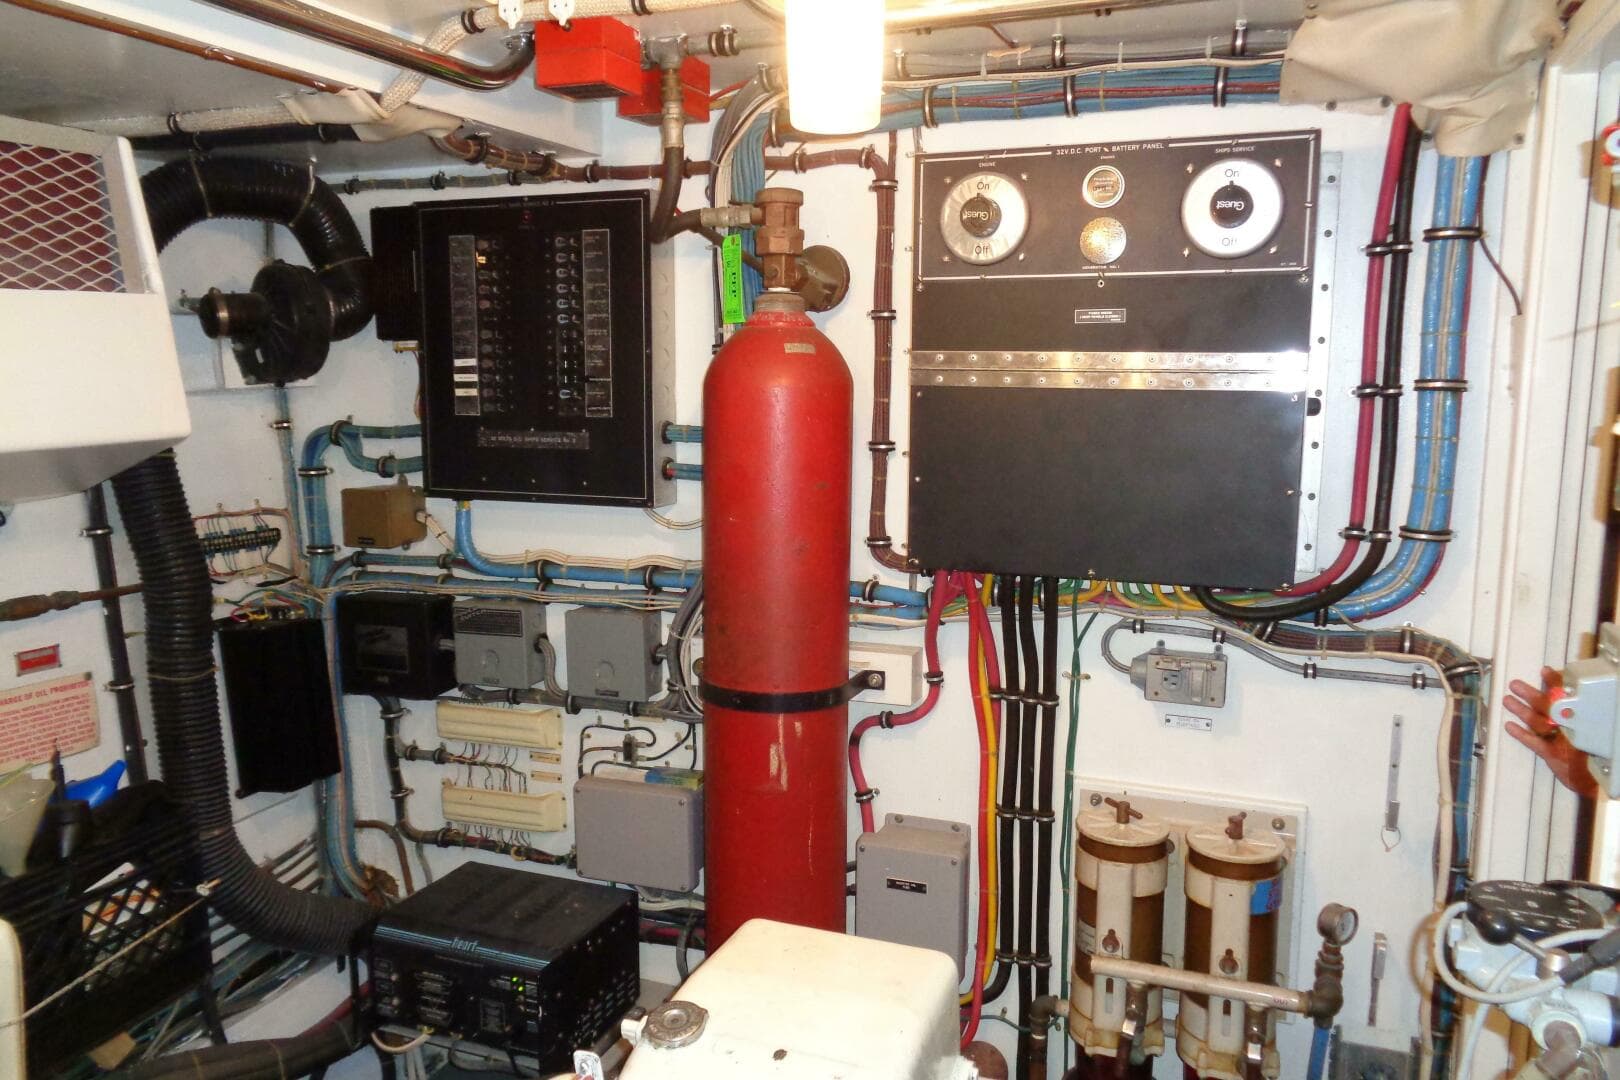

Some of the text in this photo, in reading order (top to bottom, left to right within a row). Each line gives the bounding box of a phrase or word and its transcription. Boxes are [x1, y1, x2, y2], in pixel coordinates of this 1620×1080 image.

[1111, 144, 1140, 152] BATTERY
[1224, 168, 1240, 178] On
[976, 181, 990, 191] On
[1216, 200, 1245, 211] Guest
[962, 210, 989, 221] Guest
[974, 245, 989, 255] Off
